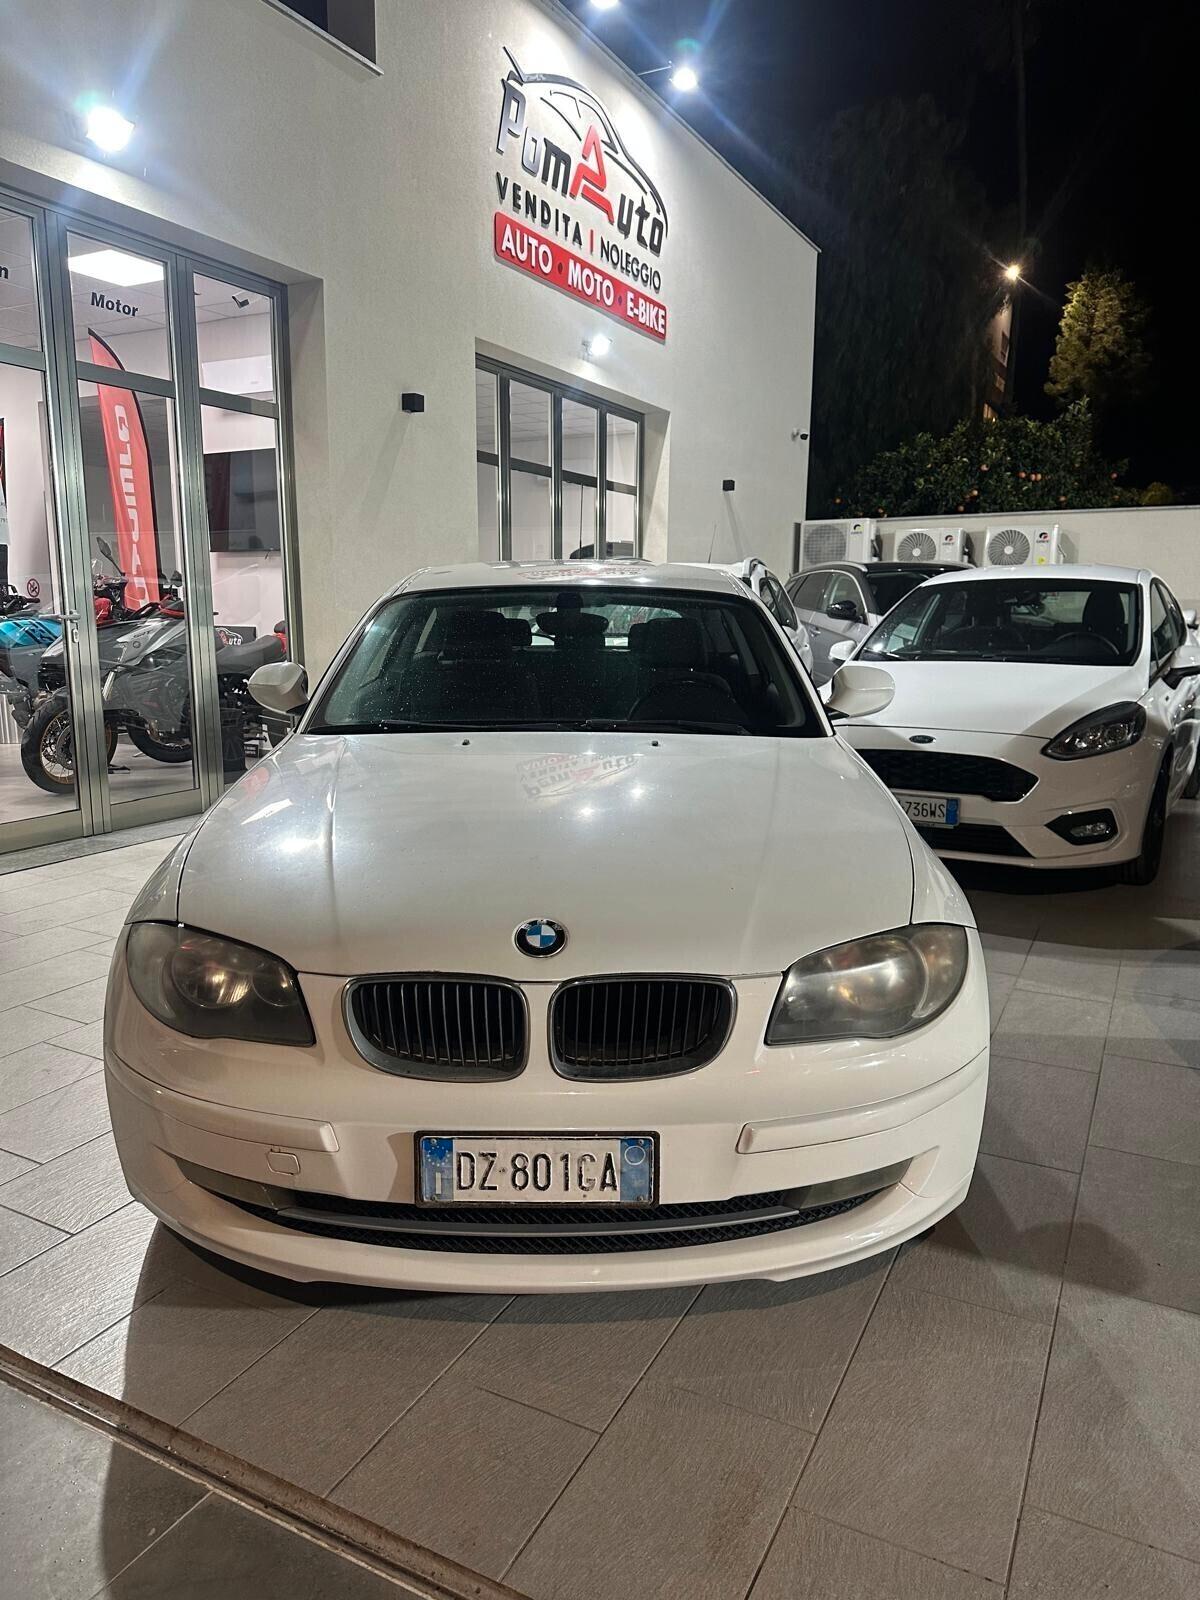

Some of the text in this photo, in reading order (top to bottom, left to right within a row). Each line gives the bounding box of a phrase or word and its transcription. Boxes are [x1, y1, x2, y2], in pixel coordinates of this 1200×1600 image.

[496, 172, 662, 293] VENDITA NOLEGGIO
[91, 292, 139, 317] Motor
[501, 224, 667, 335] AUTO MOTO E-BIKE
[456, 1152, 498, 1192] DZ
